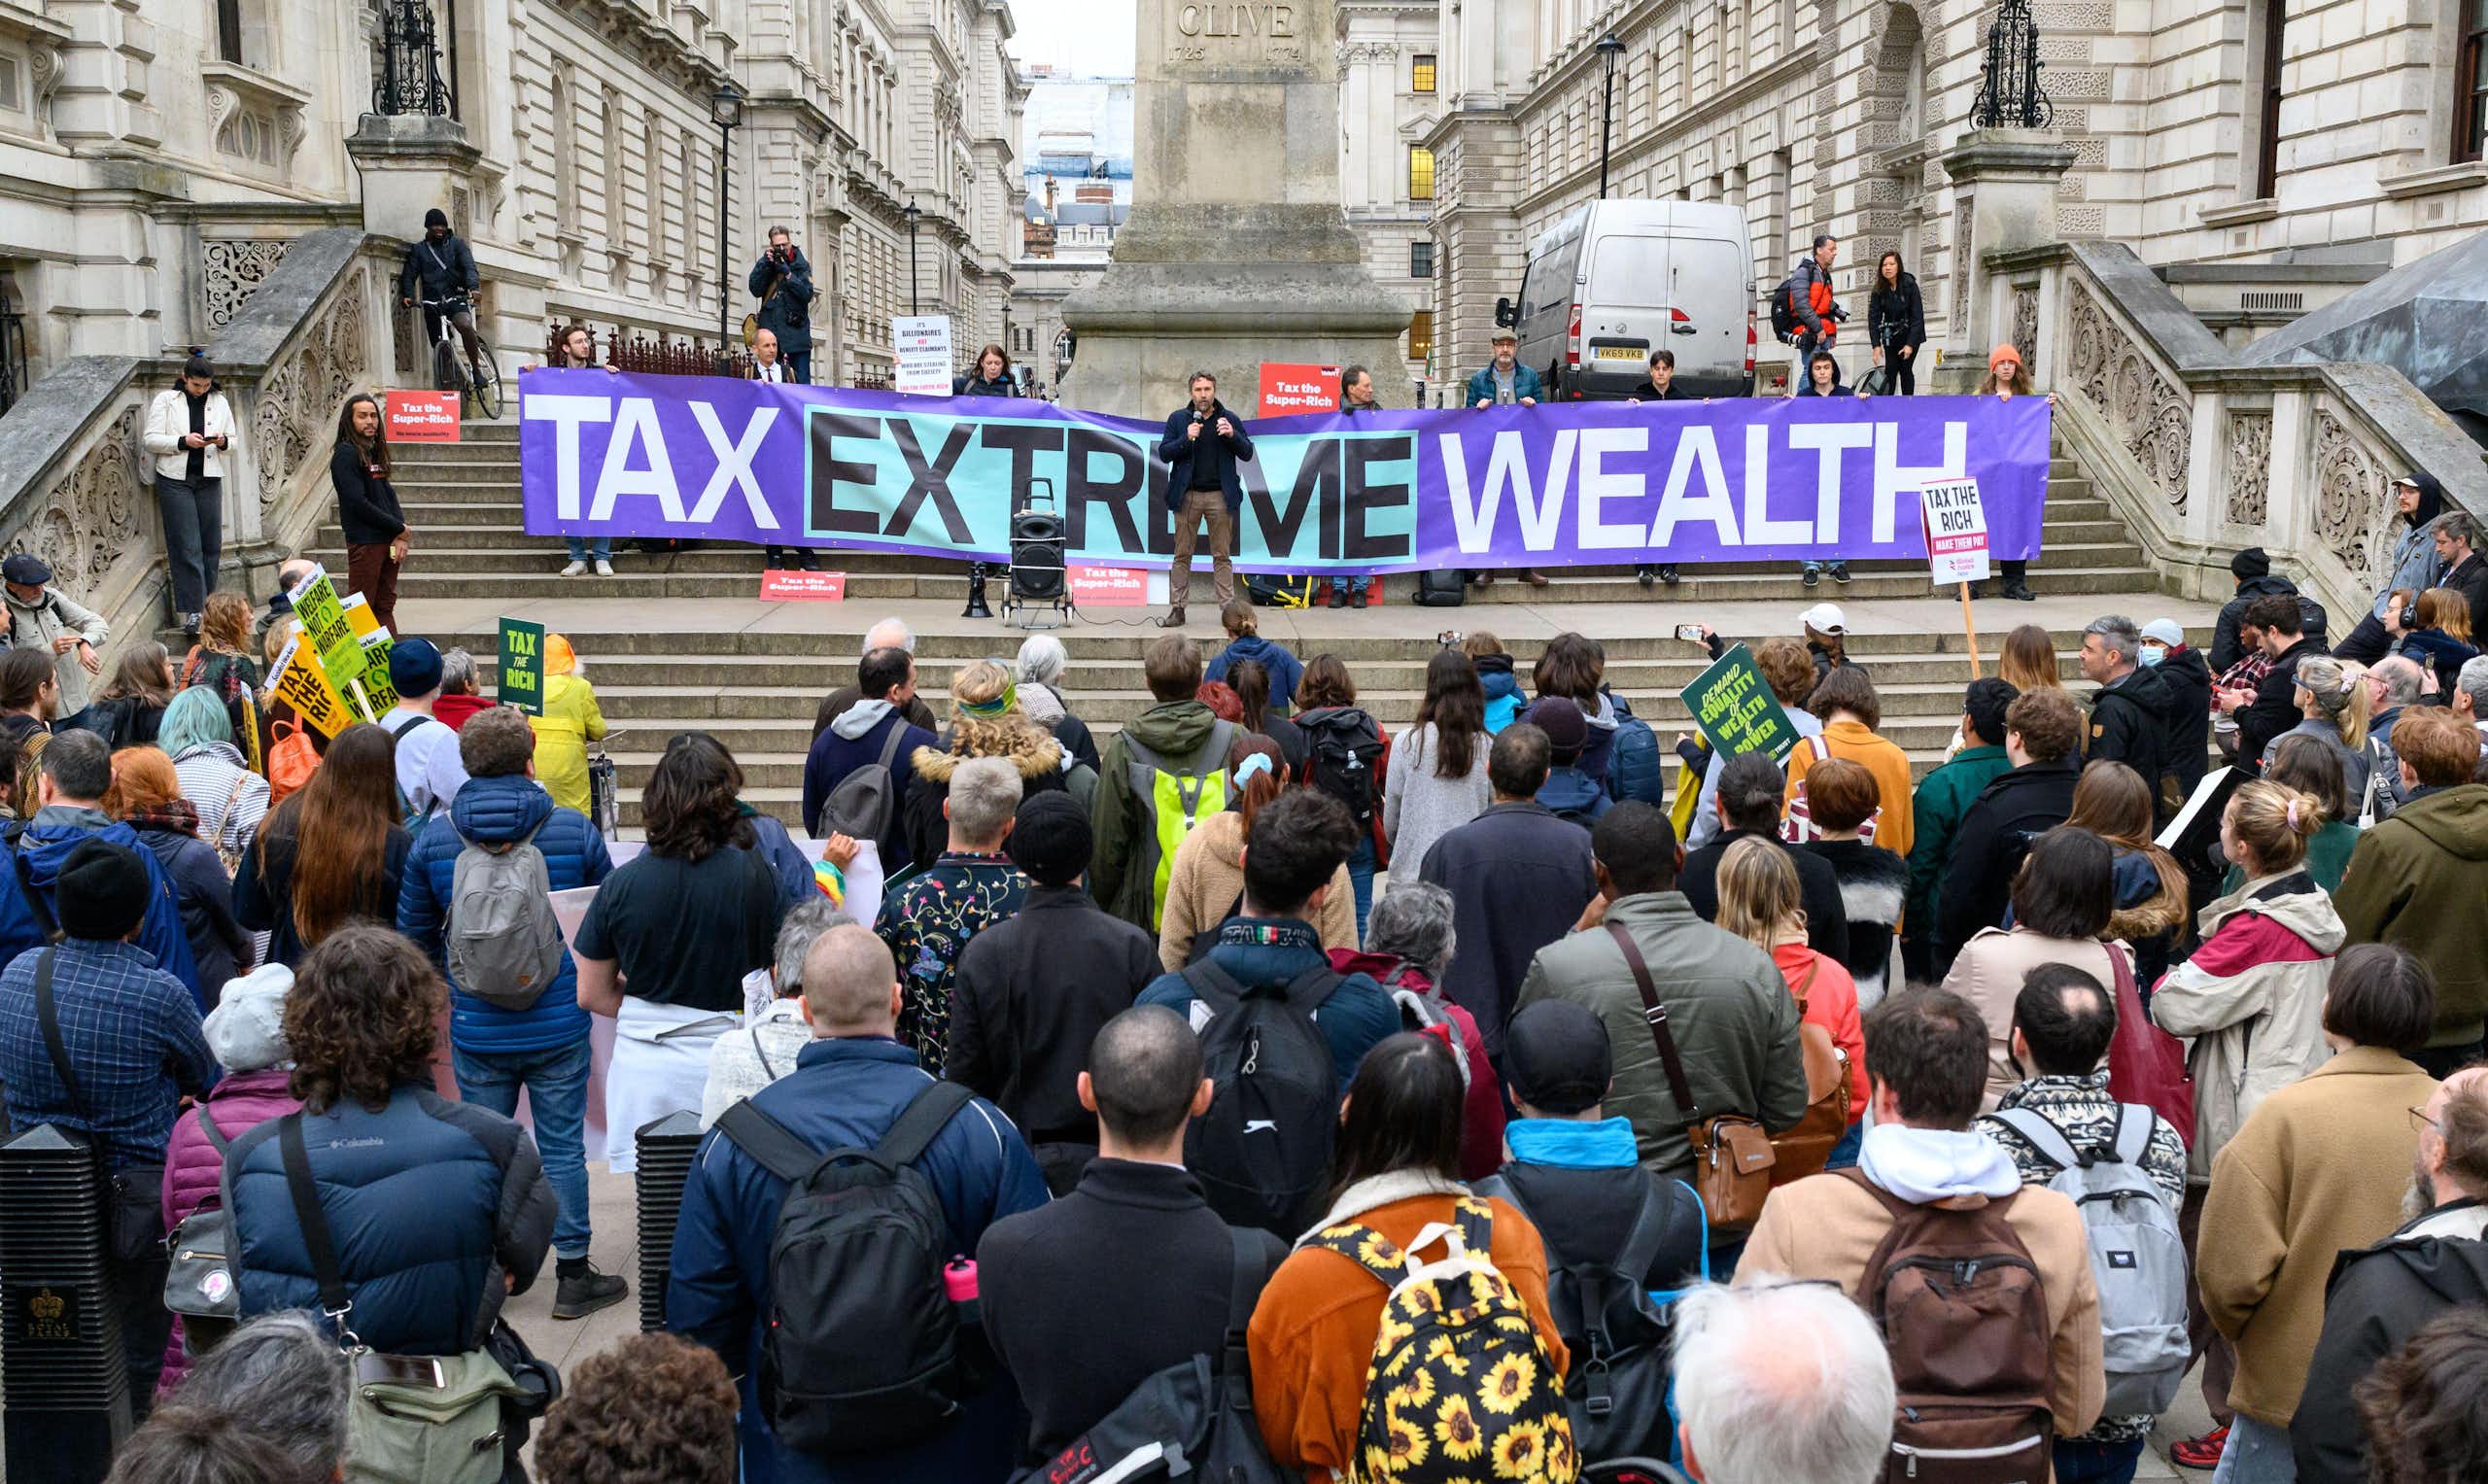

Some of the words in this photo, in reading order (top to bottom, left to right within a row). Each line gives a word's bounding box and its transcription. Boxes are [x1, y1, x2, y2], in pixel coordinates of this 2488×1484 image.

[1178, 5, 1294, 37] CLIVE
[1166, 47, 1205, 60] 1725
[1266, 48, 1301, 61] 1774
[902, 328, 942, 337] BILLIONAIRES
[1601, 349, 1624, 359] VK69
[1626, 349, 1642, 359] VKB
[1276, 381, 1299, 394] Tax
[1300, 383, 1322, 394] the
[401, 402, 423, 413] Tax
[424, 403, 443, 413] the
[1265, 394, 1332, 407] Super-Rich
[392, 414, 454, 425] Super-Rich
[524, 394, 781, 530] TAX
[1438, 421, 1967, 554] WEALTH
[1925, 487, 1952, 509] TAX
[1952, 485, 1978, 506] THE
[1941, 509, 1974, 532] RICH
[1935, 538, 1955, 552] MAKE
[1954, 537, 1973, 550] THEM
[1973, 535, 1985, 548] PAY
[1073, 577, 1141, 590] Super-Rich
[1084, 568, 1107, 577] Tax
[1108, 569, 1129, 577] the
[769, 583, 837, 592] Super-Rich
[296, 579, 331, 620] WELFARE
[306, 611, 325, 639] NOT
[314, 614, 351, 657] WARFARE
[506, 629, 536, 656] TAX
[512, 656, 529, 668] THE
[277, 659, 309, 697] TAX
[341, 674, 370, 703] NT
[505, 667, 536, 692] RICH
[1702, 663, 1740, 708] DEMAND
[293, 671, 322, 709] THE
[1699, 670, 1755, 725] EQUALITY
[308, 689, 332, 723] RIC
[1730, 694, 1741, 717] OF
[1717, 694, 1767, 741] WEALTH
[1745, 720, 1753, 738] &
[1734, 718, 1779, 755] POWER
[1775, 737, 1791, 754] TRUST
[340, 1135, 385, 1148] Columbia
